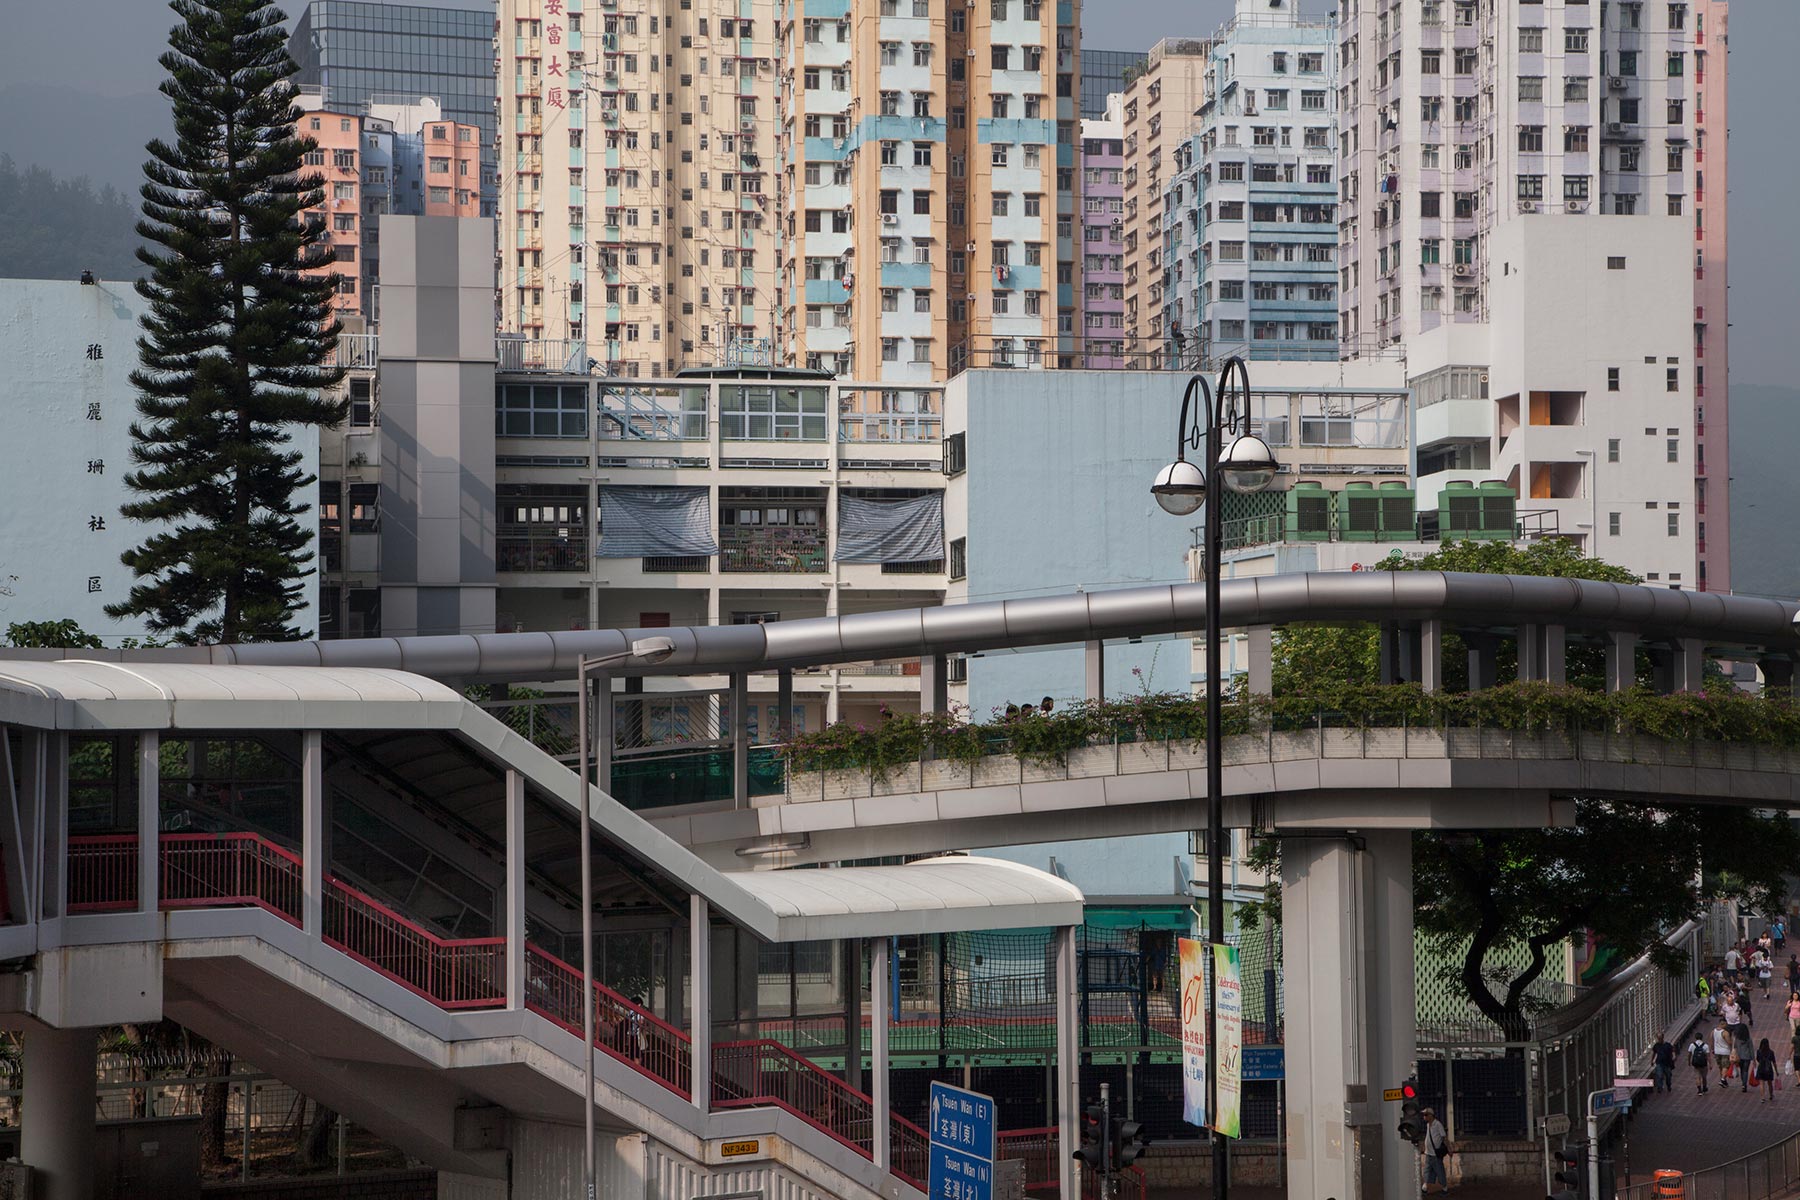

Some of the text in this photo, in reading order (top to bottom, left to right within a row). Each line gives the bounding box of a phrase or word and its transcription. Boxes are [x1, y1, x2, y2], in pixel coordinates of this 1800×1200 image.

[86, 343, 106, 593] 雅麗珊社區
[1183, 972, 1203, 1025] 67
[942, 1094, 986, 1120] Tsuen Wan (E)
[724, 1144, 750, 1154] NF343
[944, 1155, 988, 1183] Tsuen Wan (N)
